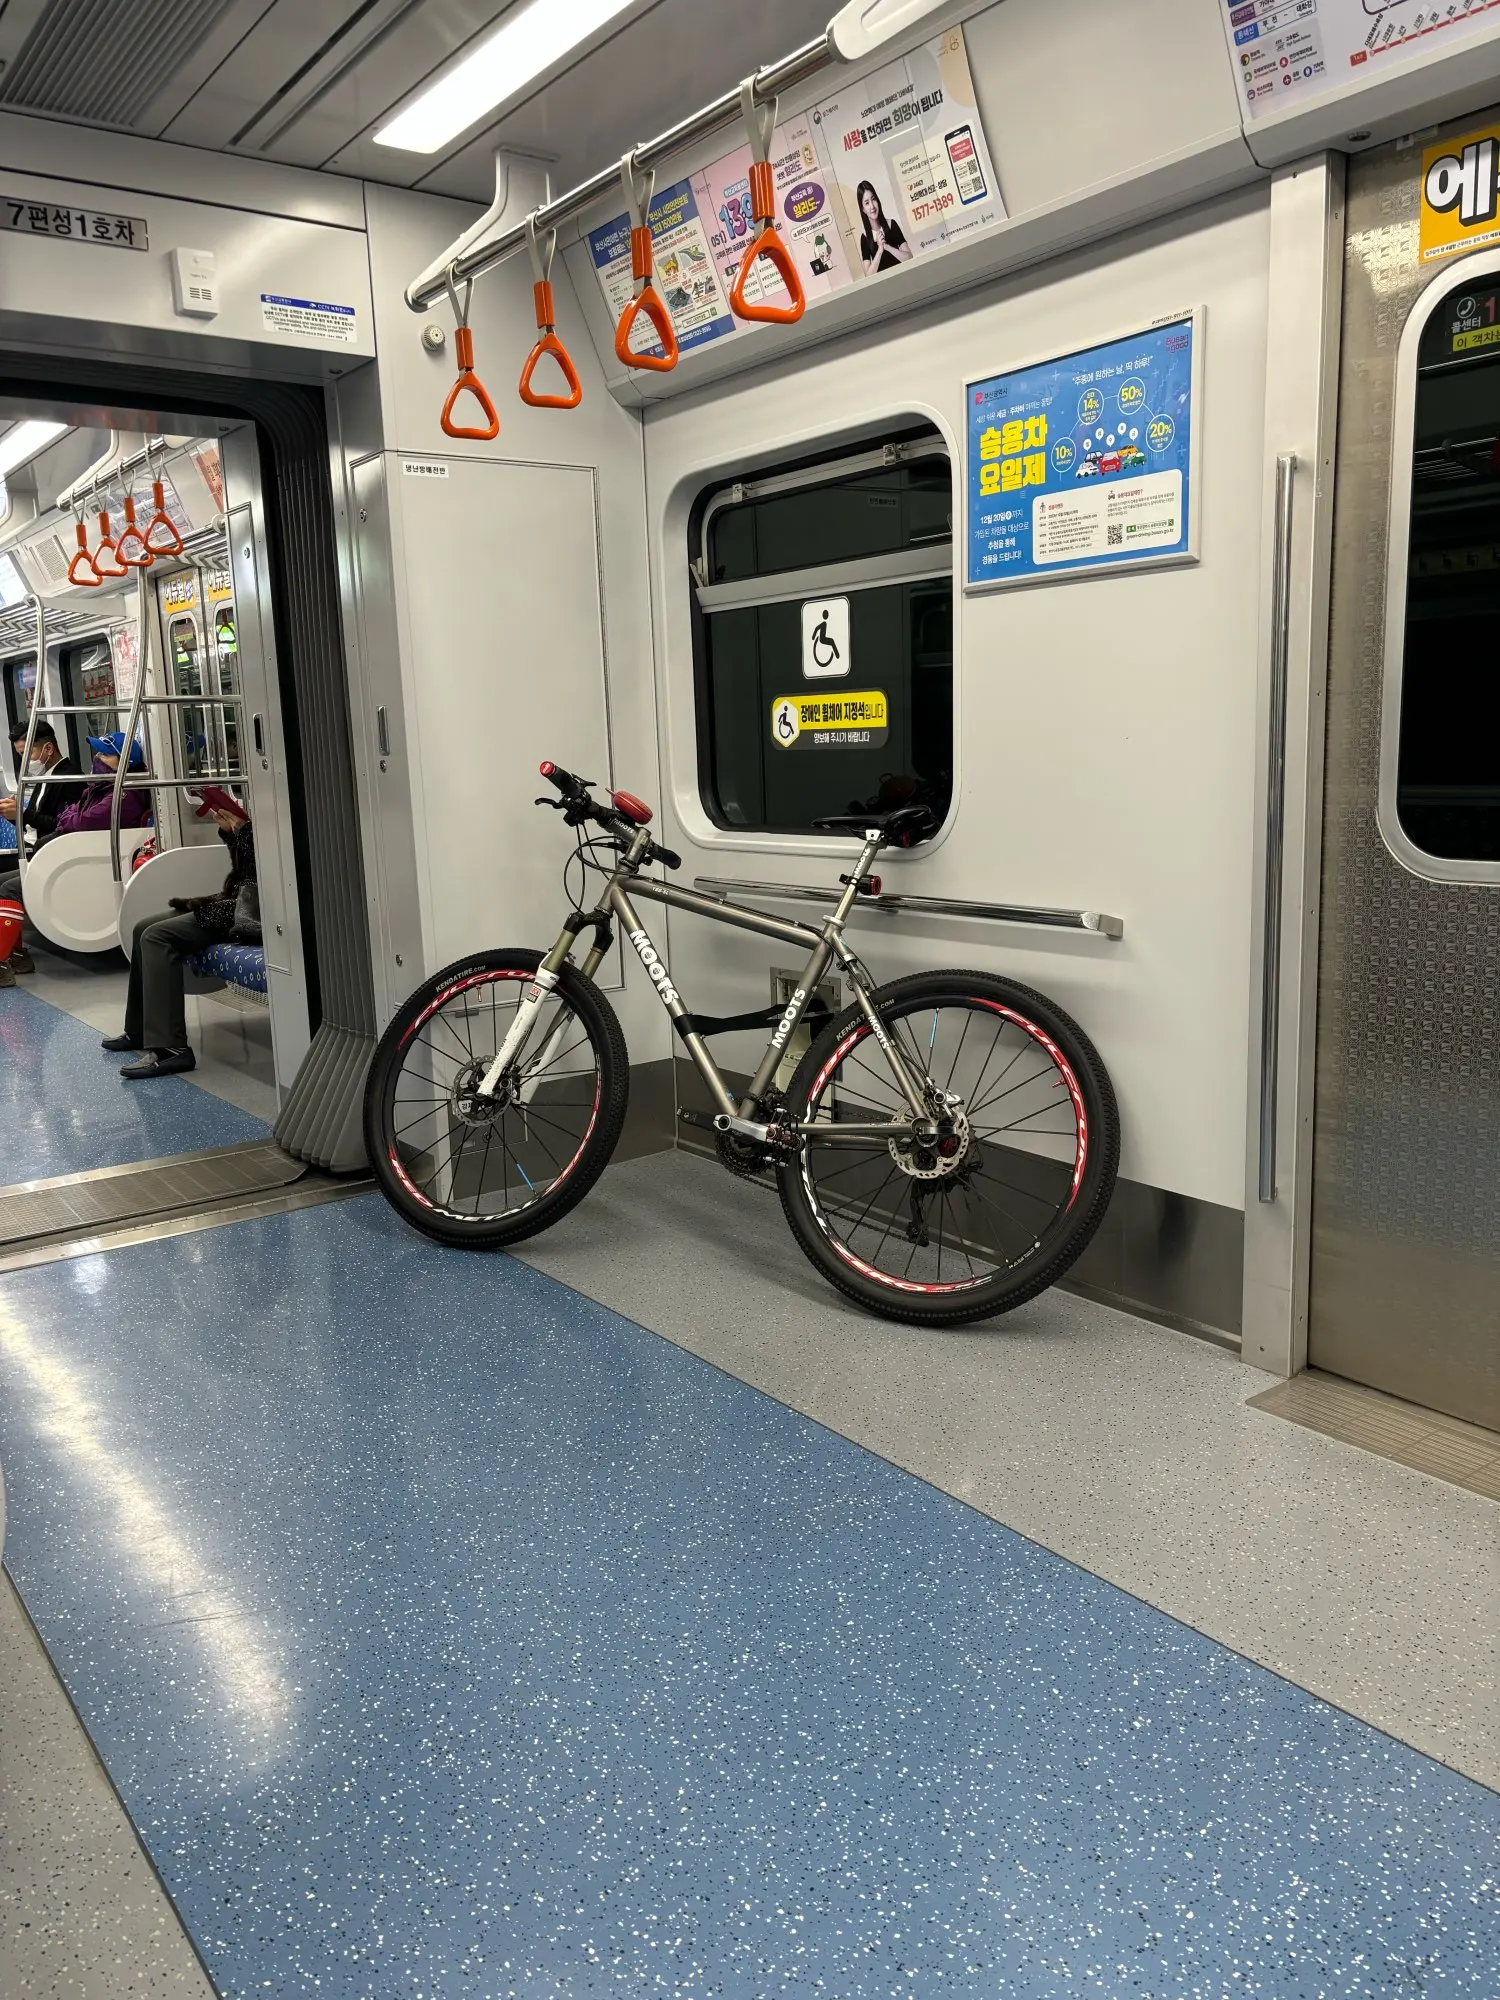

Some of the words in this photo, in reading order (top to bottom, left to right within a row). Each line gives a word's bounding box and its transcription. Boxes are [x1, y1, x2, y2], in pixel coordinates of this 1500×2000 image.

[842, 127, 866, 150] 사랑을
[867, 117, 891, 138] 전하면
[892, 99, 920, 124] 희망이
[920, 90, 942, 110] 됩니다
[912, 192, 953, 221] 1577-1389
[710, 231, 726, 246] 051)
[1451, 315, 1482, 334] 콜센터
[1457, 336, 1468, 348] 이
[1121, 384, 1141, 401] 50%
[1083, 397, 1098, 410] 14%
[980, 414, 1047, 459] 승용차
[1150, 420, 1172, 437] 20%
[1055, 444, 1072, 459] 10%
[979, 452, 1045, 495] 요일제
[980, 514, 992, 524] 12월
[974, 528, 989, 539] 가입된
[990, 525, 1006, 536] 차량을
[1007, 521, 1028, 533] 대상으로
[800, 703, 820, 723] 장애인
[822, 702, 842, 722] 휠체어
[844, 701, 883, 721] 지정석입니다
[814, 732, 829, 743] 양보해
[830, 732, 846, 743] 주시기
[847, 732, 870, 742] 바랍니다
[629, 929, 679, 1004] MOOTS
[435, 965, 486, 993] KENDATIRE.COM
[771, 988, 806, 1049] MOOTS
[868, 1015, 891, 1049] MOOTS
